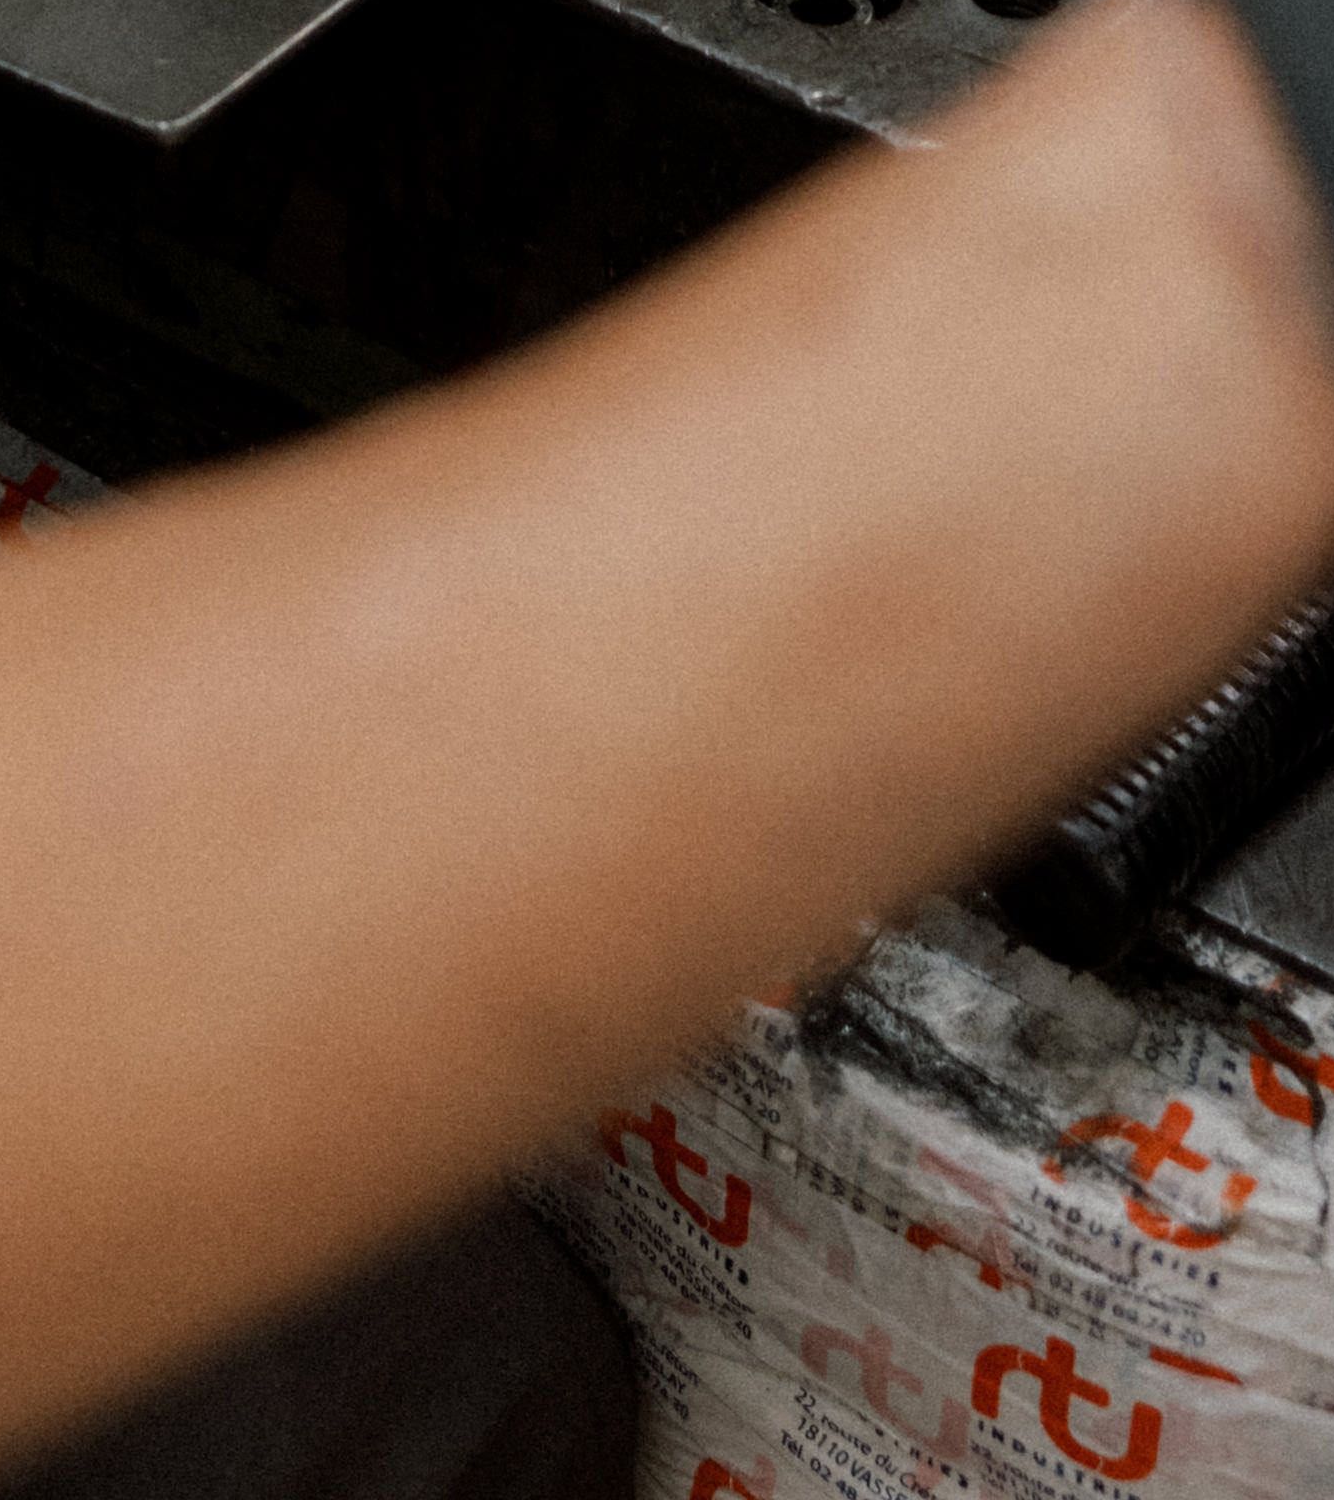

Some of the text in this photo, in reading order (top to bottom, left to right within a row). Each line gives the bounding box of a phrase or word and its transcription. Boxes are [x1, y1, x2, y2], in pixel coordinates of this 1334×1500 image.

[608, 1164, 749, 1286] INDUSTRIES
[673, 1242, 704, 1271] du
[1031, 1187, 1220, 1288] INDUSTRIES
[776, 1430, 811, 1462] Tél.
[806, 1457, 835, 1482] 02
[790, 1387, 824, 1419] 22,
[818, 1414, 873, 1457] route
[873, 1452, 901, 1477] du
[792, 1416, 854, 1467] 18110
